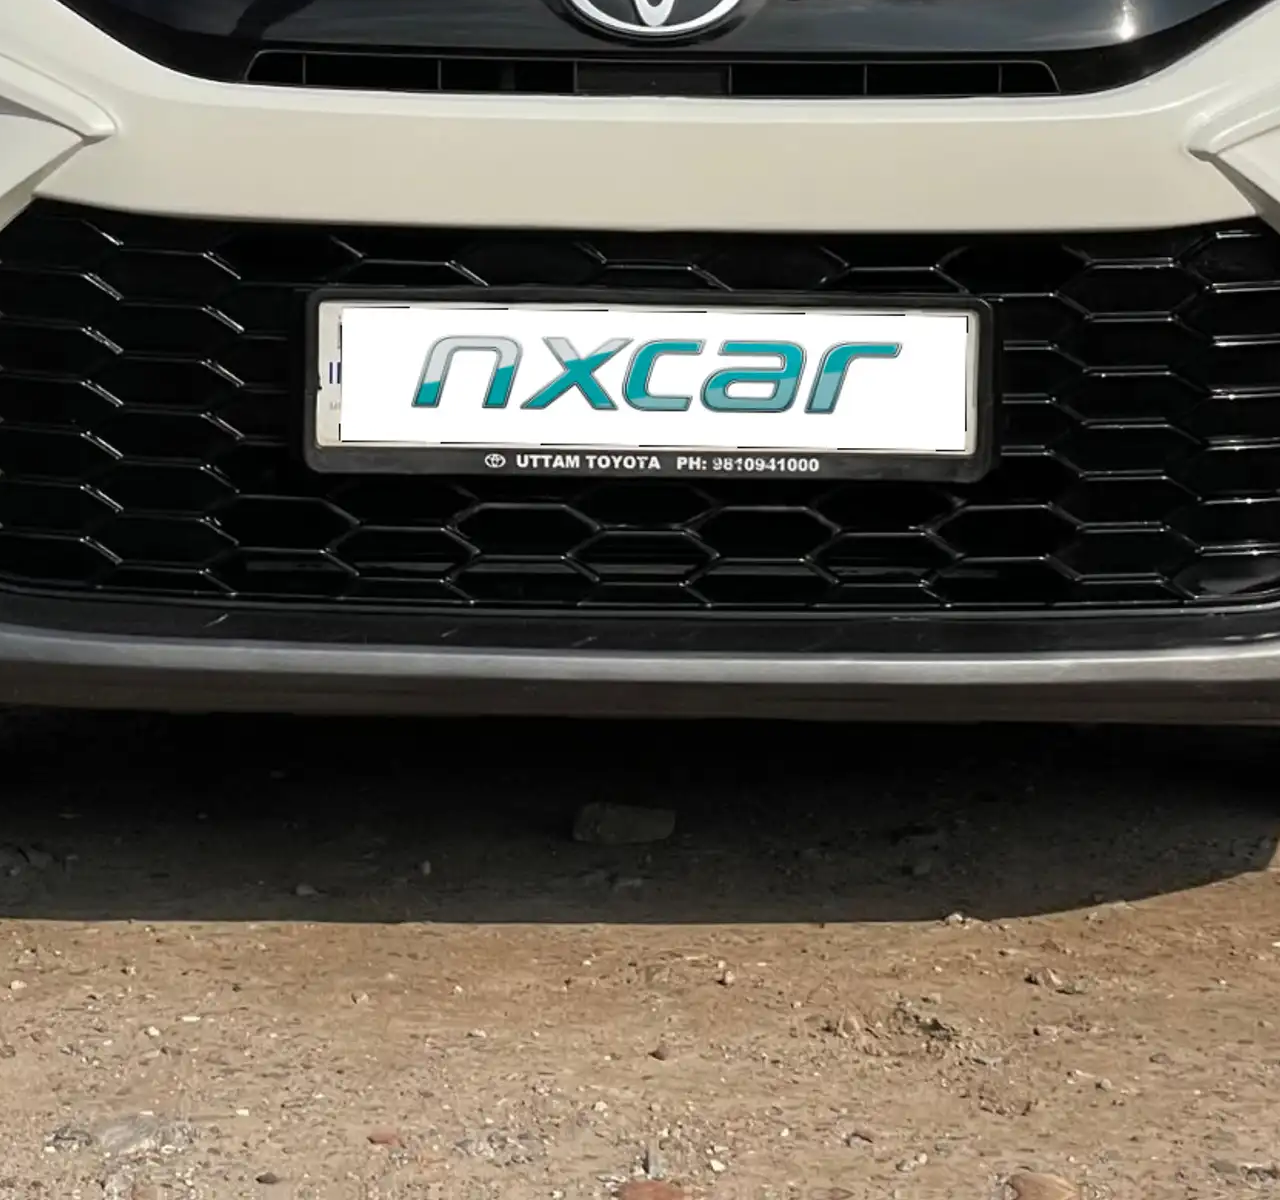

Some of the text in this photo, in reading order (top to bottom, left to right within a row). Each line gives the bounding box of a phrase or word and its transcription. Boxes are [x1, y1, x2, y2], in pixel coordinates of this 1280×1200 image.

[516, 453, 580, 469] UTTAM
[585, 454, 661, 471] TOYOTA
[676, 456, 707, 471] PH:
